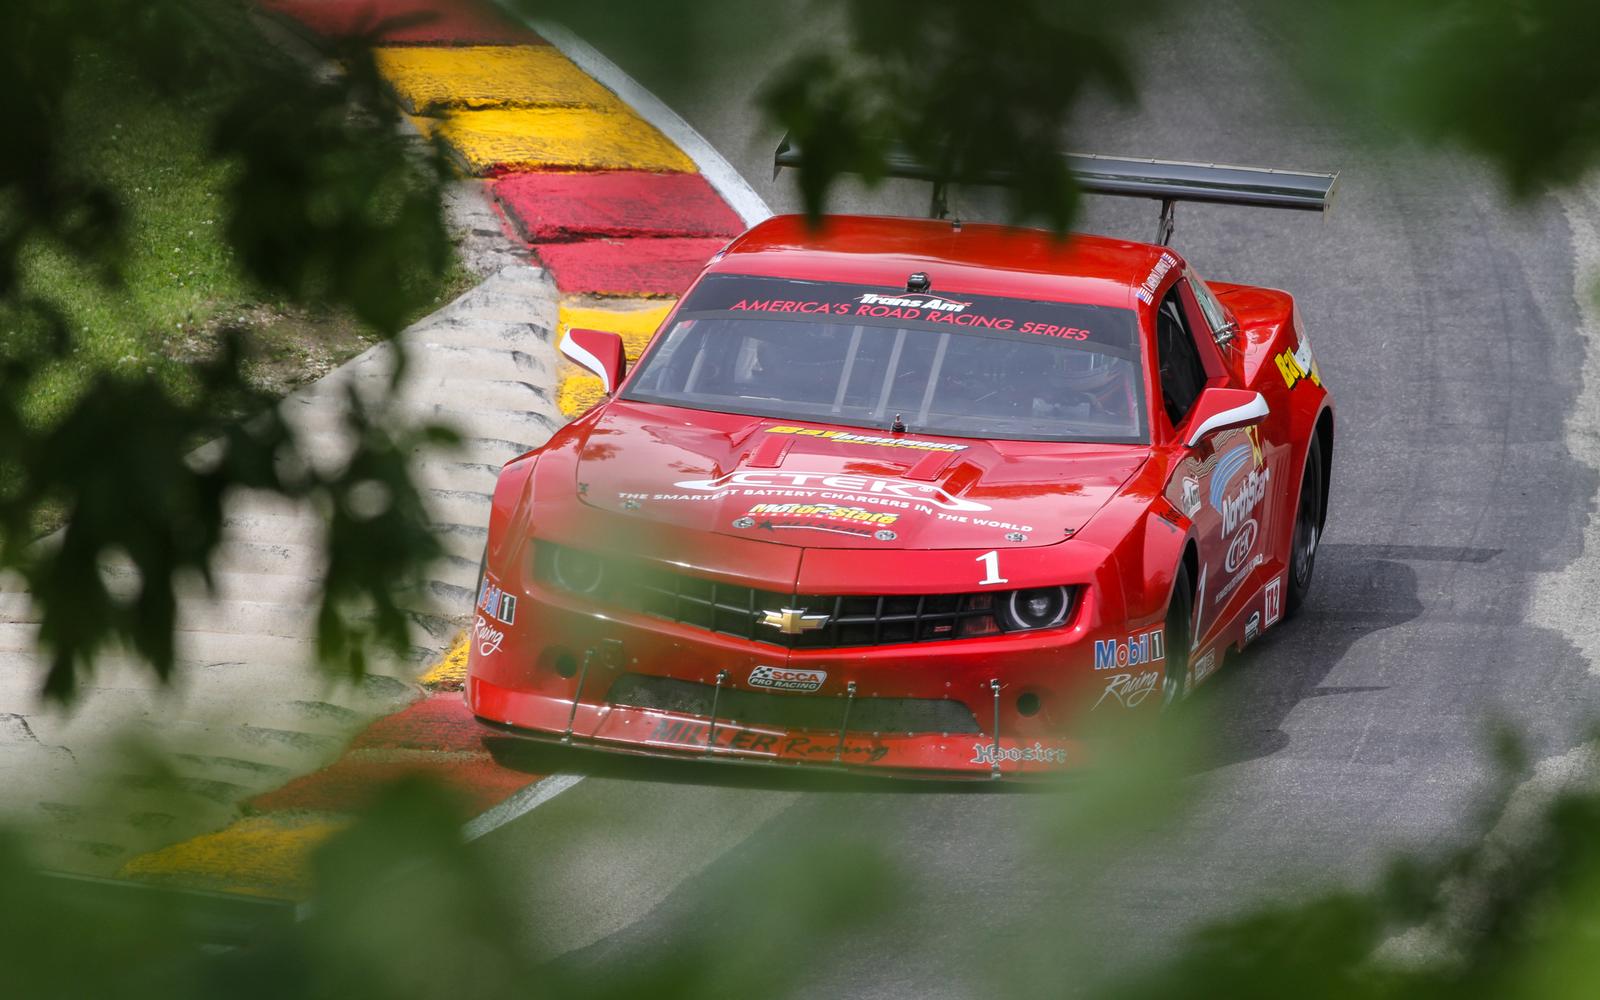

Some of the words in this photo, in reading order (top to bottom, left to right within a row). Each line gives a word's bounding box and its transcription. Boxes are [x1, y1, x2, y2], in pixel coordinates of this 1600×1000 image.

[729, 299, 852, 315] AMERICA'S
[855, 305, 921, 320] ROAD
[926, 310, 1014, 331] RACING
[1019, 321, 1091, 341] SERIES
[859, 293, 919, 308] Trans
[922, 299, 966, 313] Am
[617, 492, 649, 500] THE
[652, 489, 739, 501] SMARTEST
[743, 489, 817, 498] BATTERY
[820, 491, 909, 509] CHARGERS
[914, 504, 933, 515] IN
[937, 512, 968, 523] THE
[972, 518, 1033, 532] WORLD
[976, 550, 1008, 585] 1
[1094, 633, 1149, 670] Mobil
[751, 678, 773, 686] PRO
[774, 681, 817, 690] RACING
[771, 671, 820, 682] SCCA
[1091, 671, 1159, 711] Racing
[969, 742, 1067, 764] Hoosier
